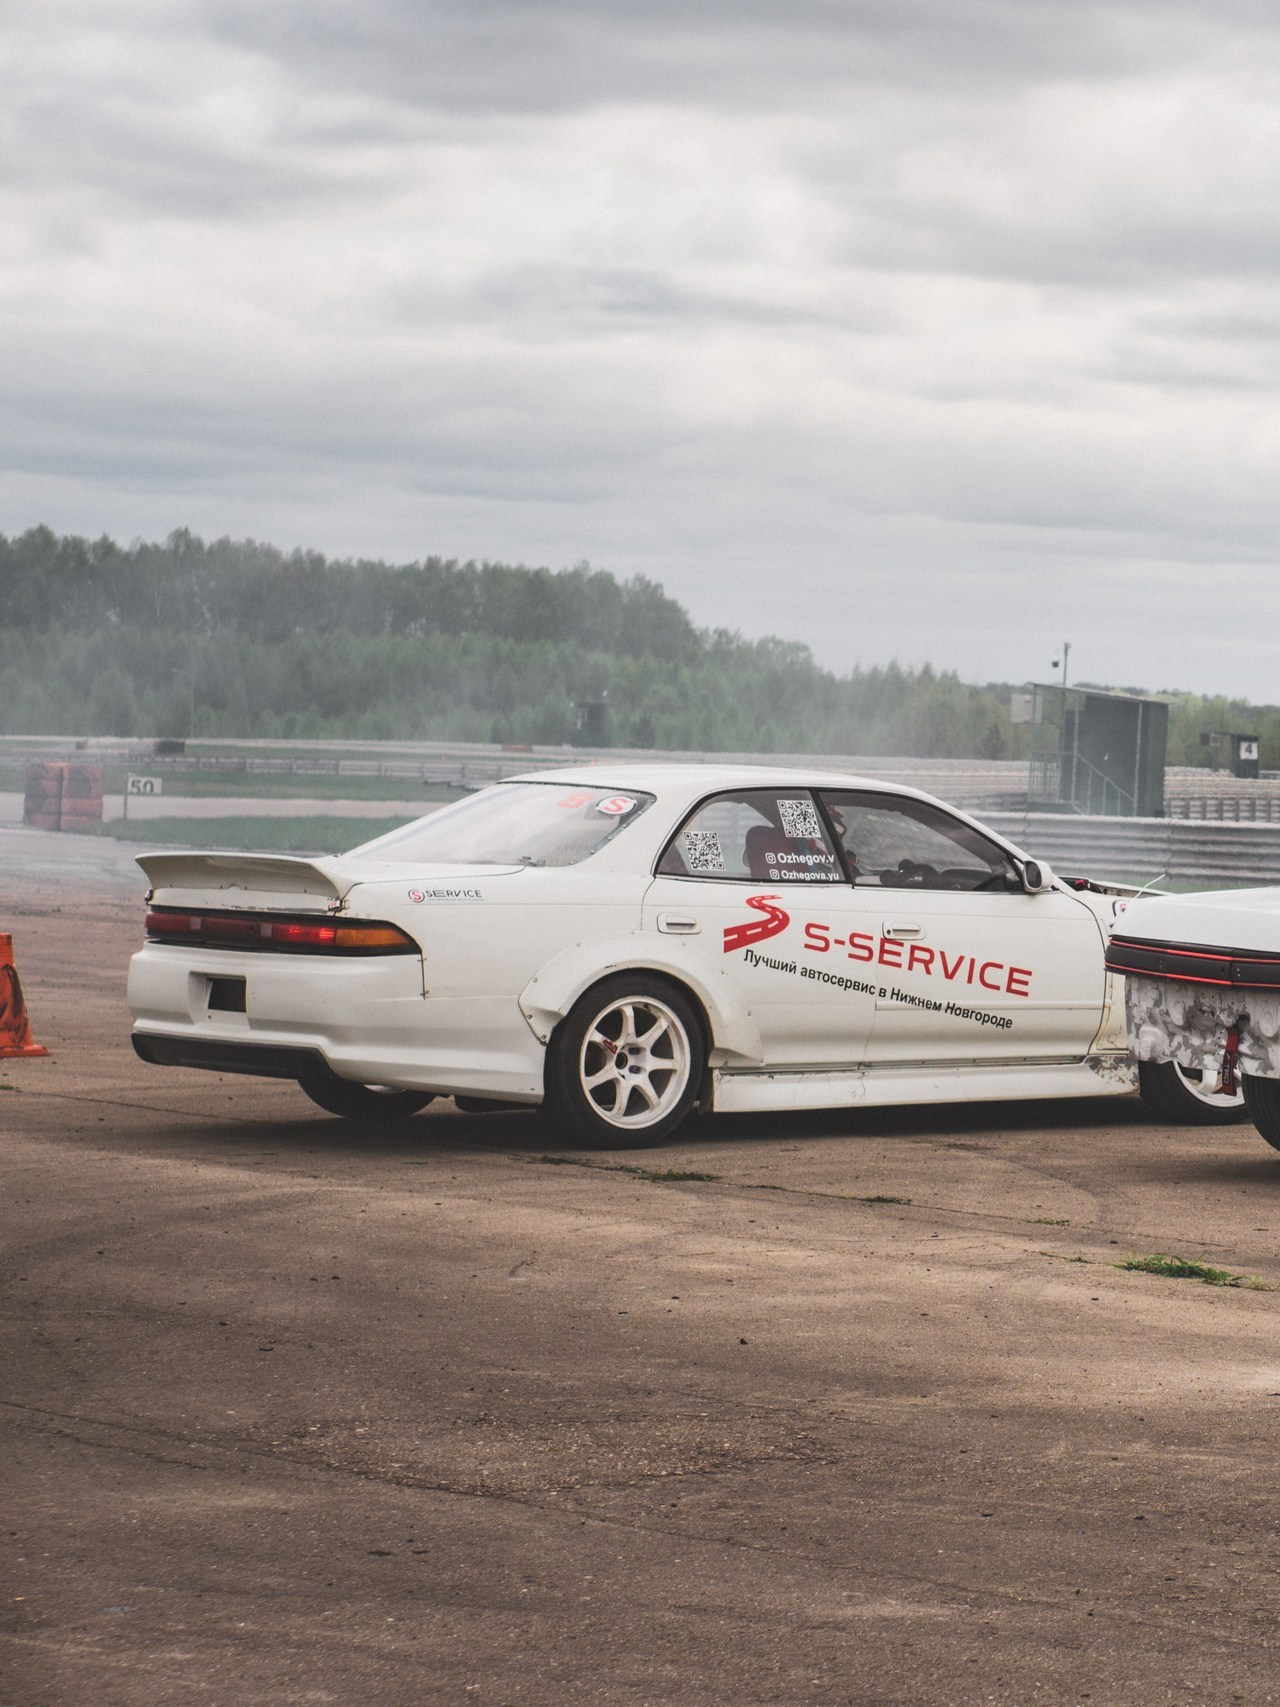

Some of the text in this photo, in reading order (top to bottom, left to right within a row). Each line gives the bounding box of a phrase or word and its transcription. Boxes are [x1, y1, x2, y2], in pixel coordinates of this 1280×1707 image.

[1244, 743, 1253, 754] 4
[131, 779, 154, 795] 50
[777, 852, 834, 866] Ozhegov.v
[781, 869, 839, 881] Ozhegova.yu
[425, 889, 482, 898] SERVICE
[804, 922, 1033, 997] S-SERVICE
[744, 949, 1013, 1030] Лучший автосервис в Нижнем Новгороде
